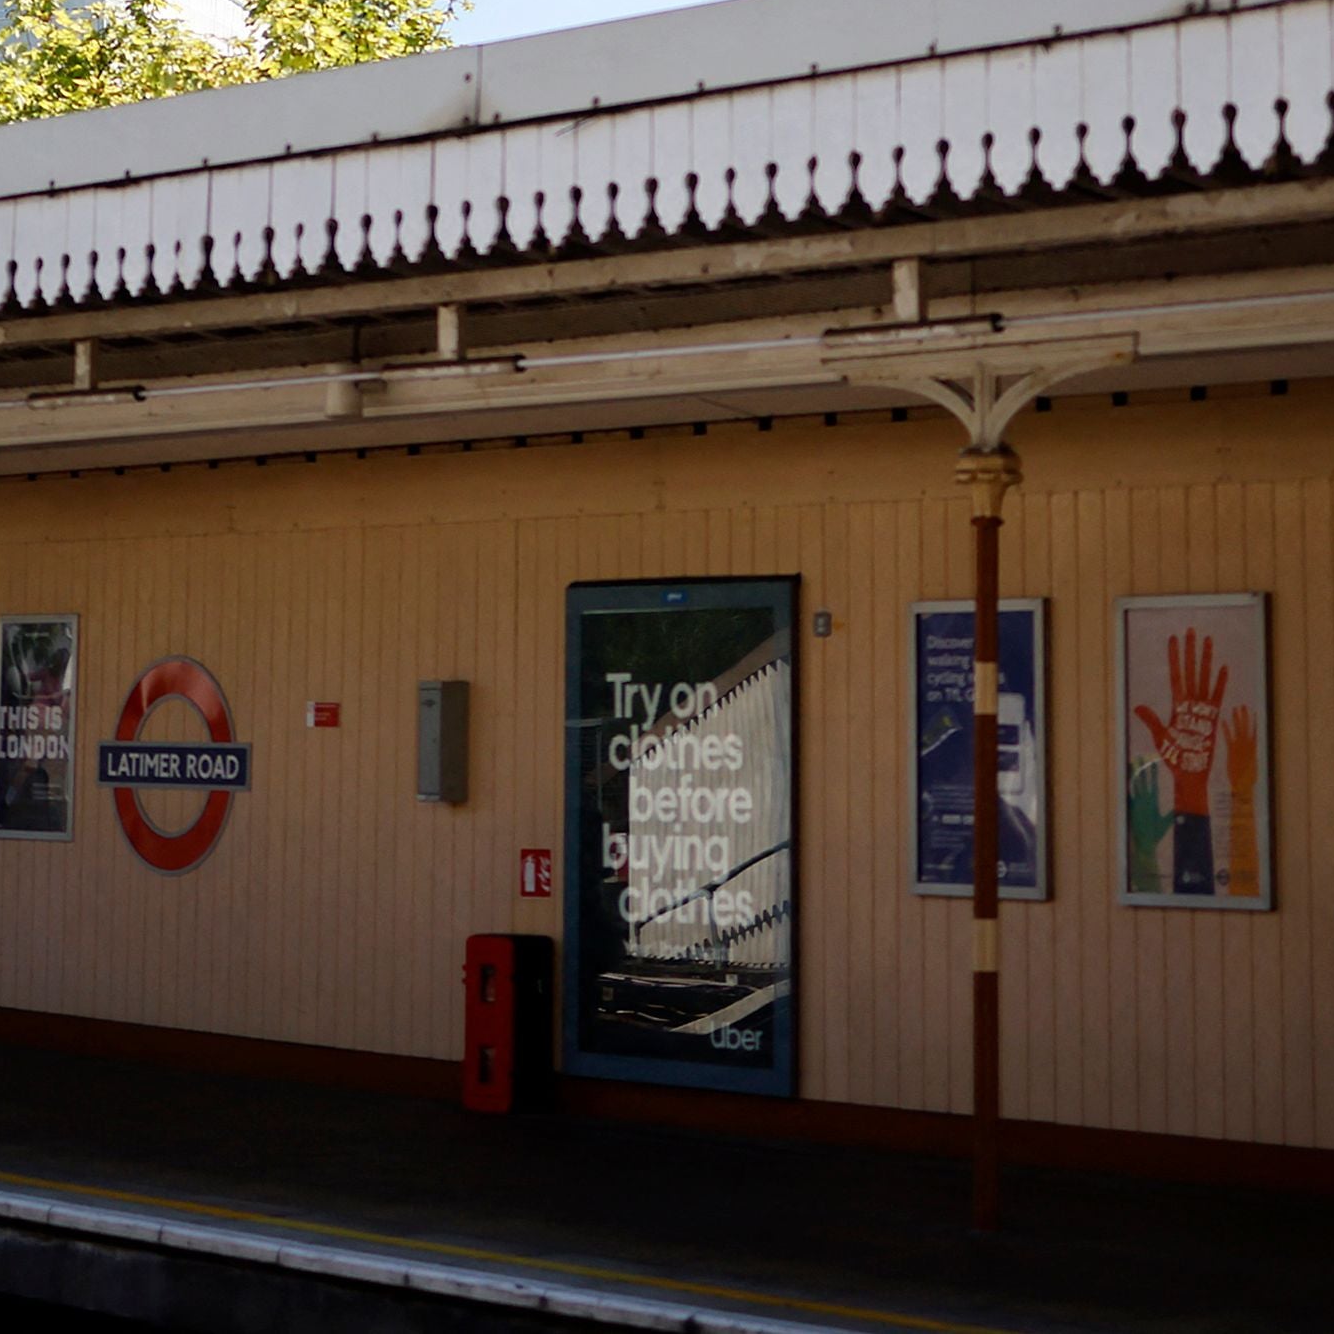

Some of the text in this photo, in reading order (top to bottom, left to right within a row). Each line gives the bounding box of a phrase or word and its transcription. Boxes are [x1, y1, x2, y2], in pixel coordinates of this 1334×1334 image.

[45, 705, 63, 731] IS
[606, 673, 718, 731] Try on
[107, 752, 240, 779] LATIMER ROAD
[608, 723, 744, 771] clothes
[629, 773, 753, 824] before
[602, 822, 730, 883] buying
[619, 877, 753, 928] clothes
[710, 1020, 764, 1051] Uber
